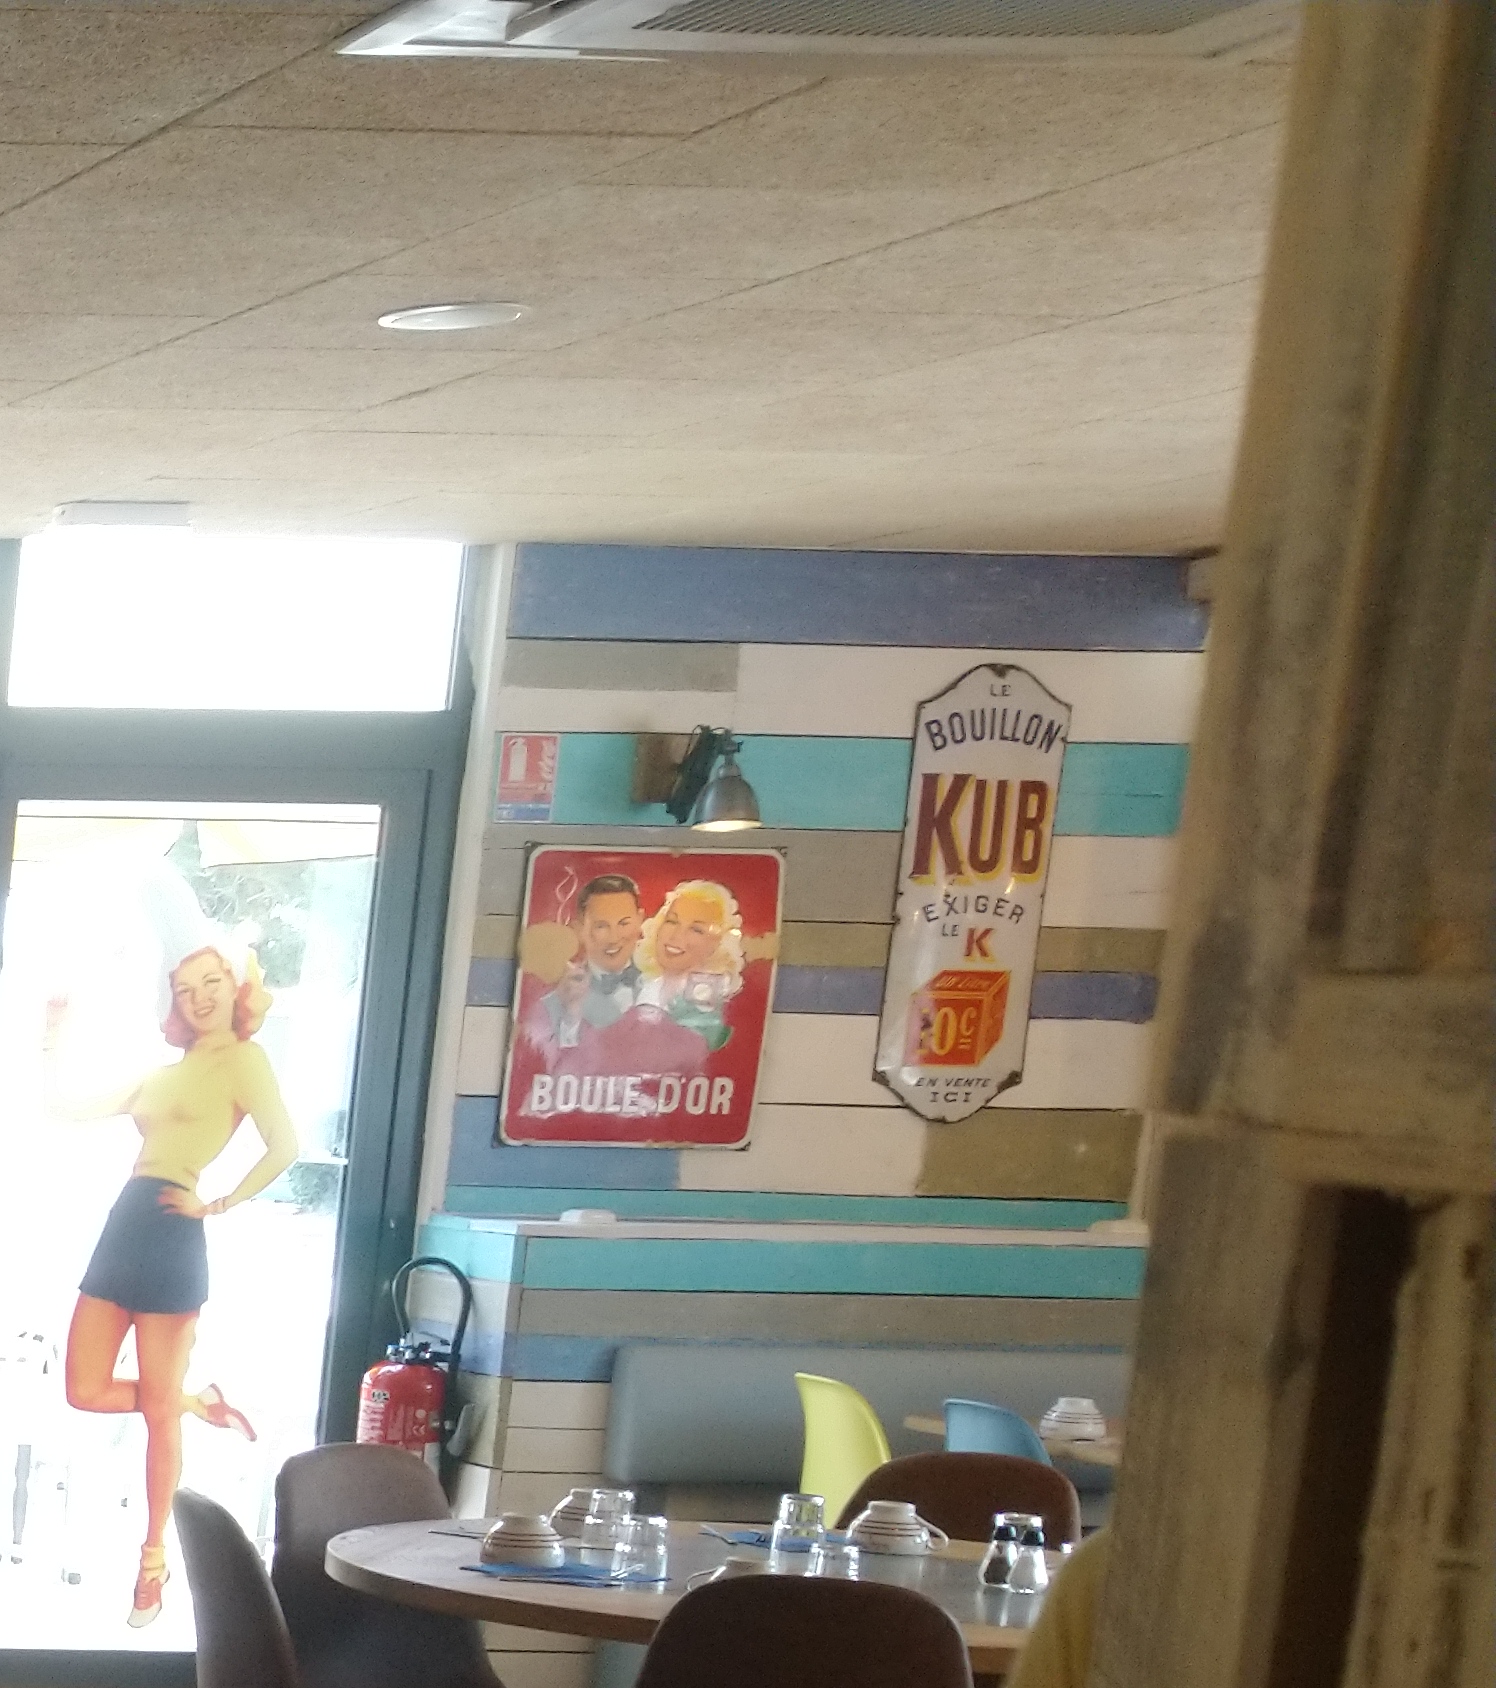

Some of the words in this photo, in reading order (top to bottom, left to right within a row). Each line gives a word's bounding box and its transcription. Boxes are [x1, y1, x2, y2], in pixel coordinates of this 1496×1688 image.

[989, 683, 1013, 698] LE
[924, 707, 1062, 755] BOUILLON
[910, 772, 1053, 886] KUB
[922, 894, 1027, 925] EXIGER
[941, 925, 961, 939] LE
[964, 926, 995, 961] K
[530, 1073, 643, 1114] BOULE
[657, 1075, 734, 1115] D'OR
[914, 1077, 939, 1088] EN
[945, 1077, 992, 1088] VENTE
[930, 1091, 973, 1103] ICI
